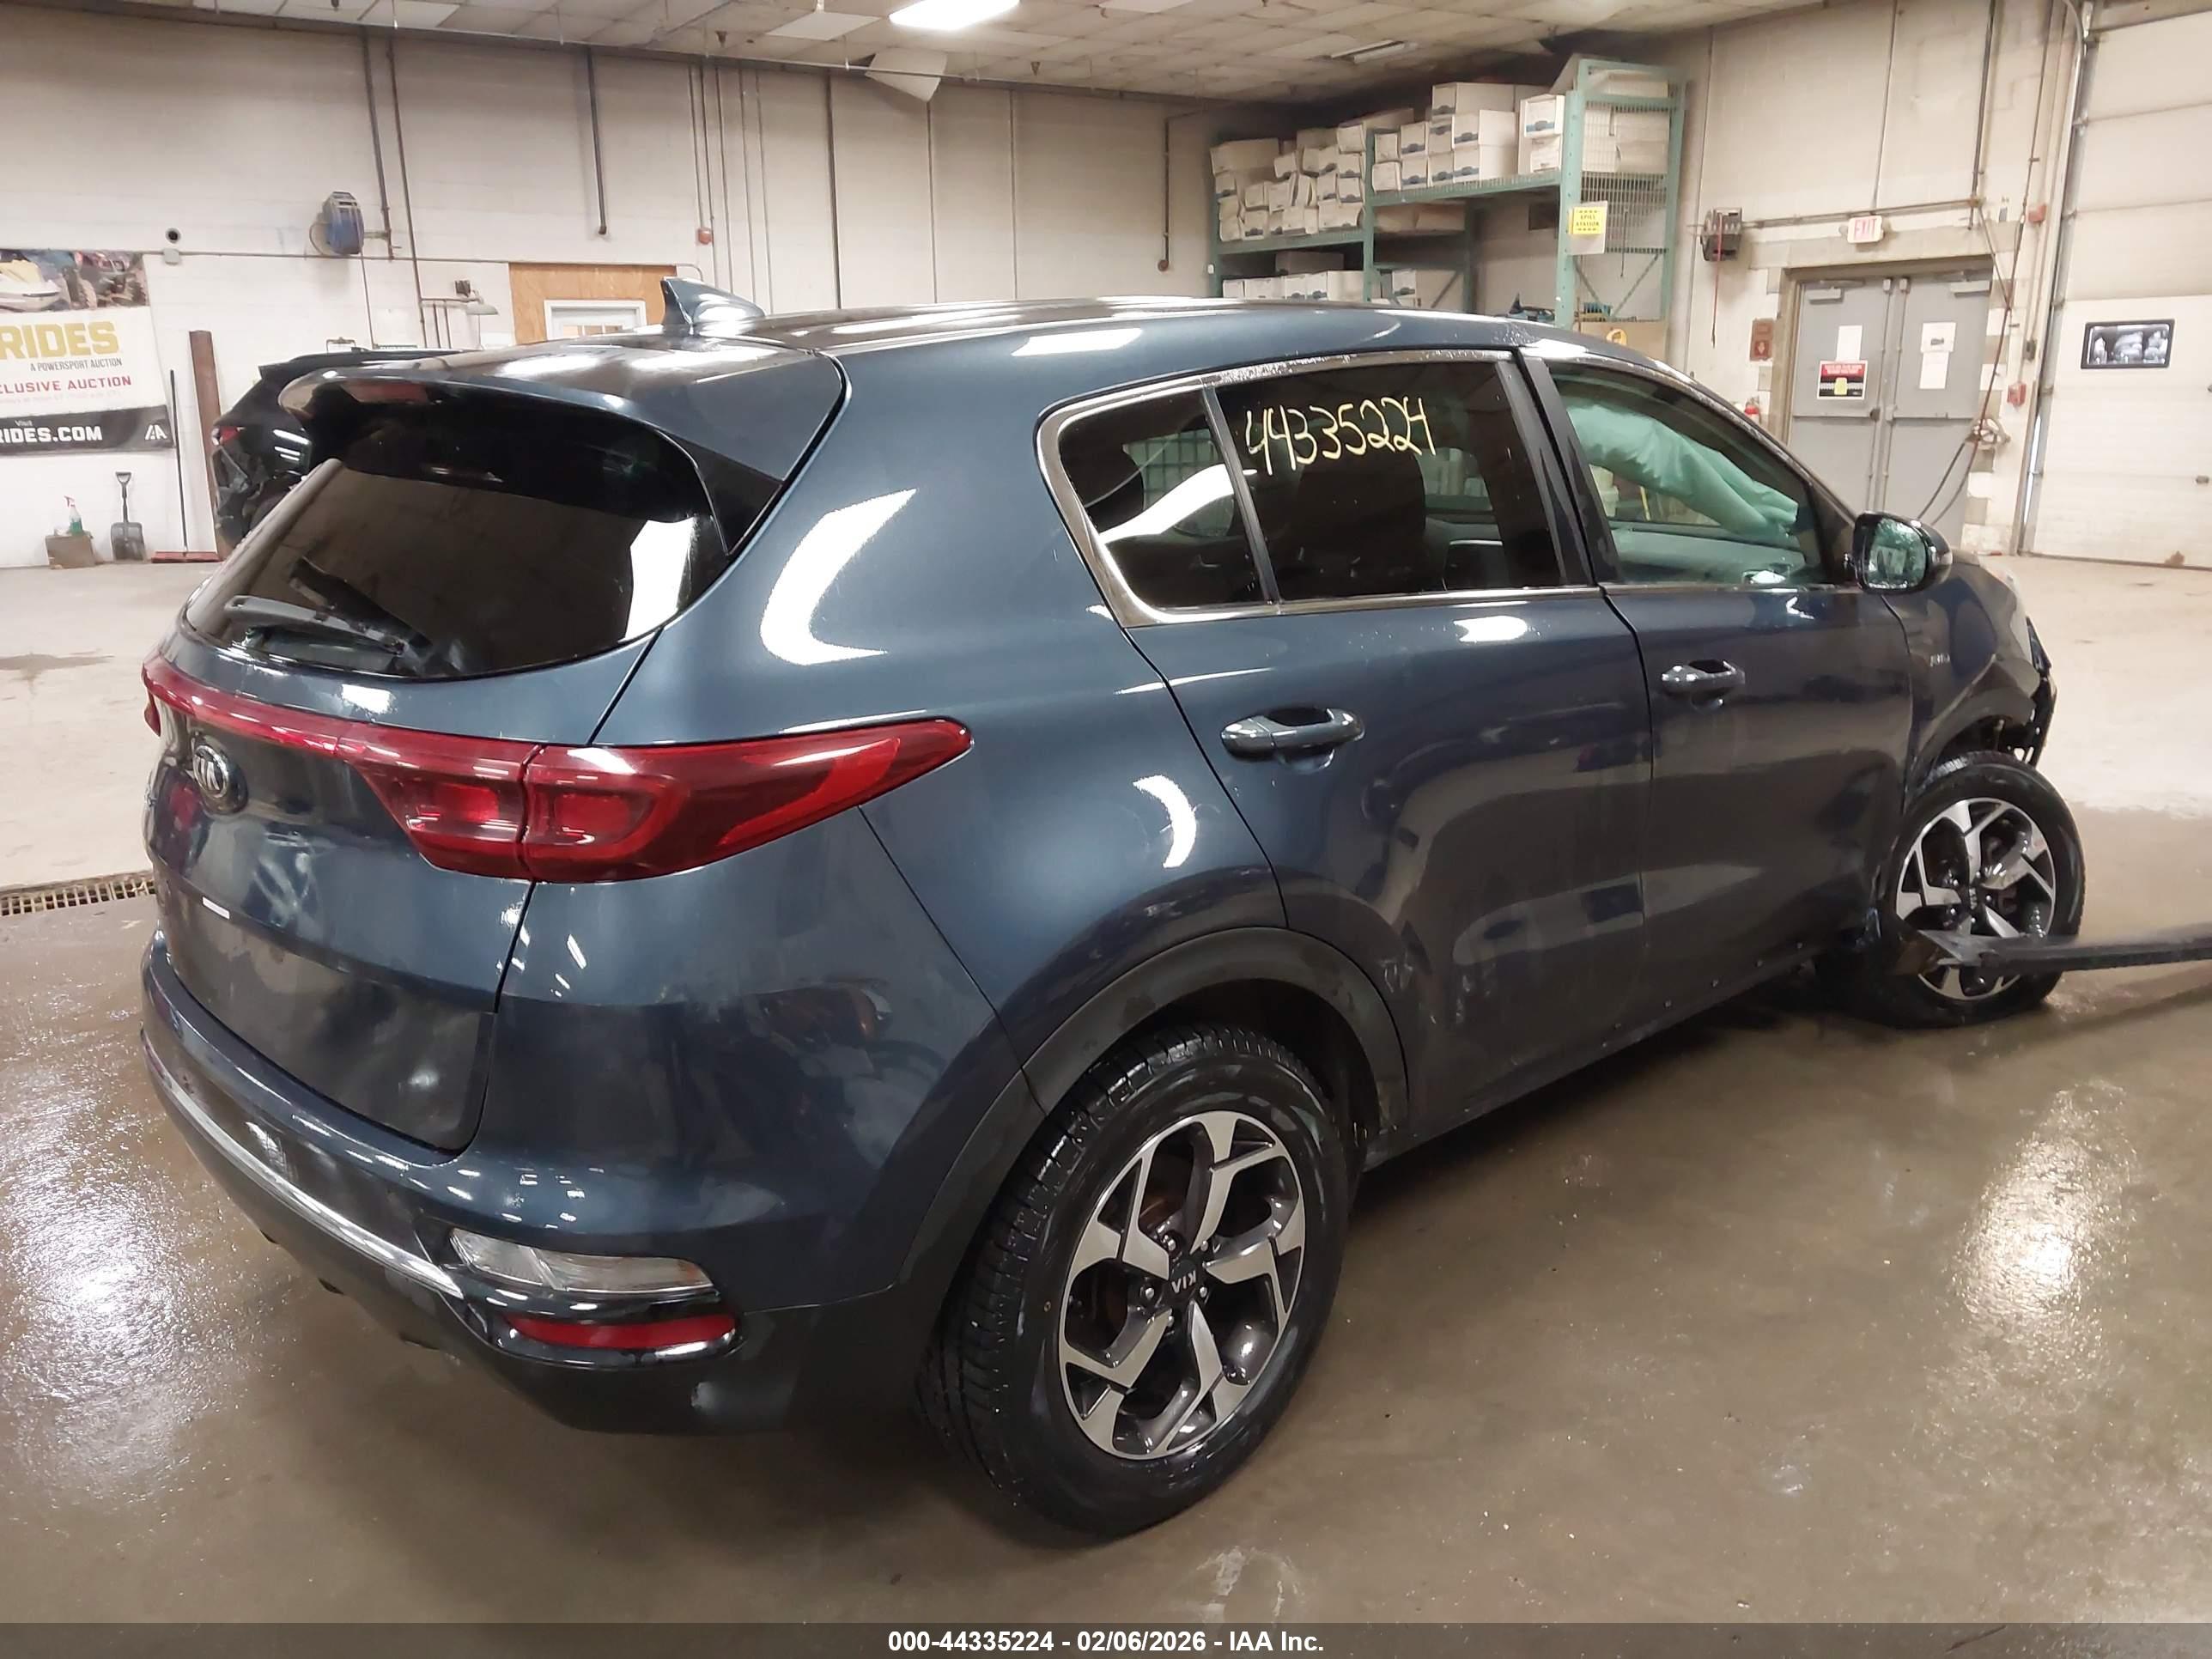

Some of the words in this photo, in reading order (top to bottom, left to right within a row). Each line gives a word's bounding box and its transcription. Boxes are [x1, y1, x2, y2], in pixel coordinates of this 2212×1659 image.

[1855, 218, 1877, 236] EXIT
[0, 321, 119, 361] RIDES
[30, 363, 36, 372] A
[38, 359, 88, 372] POWERSPORT
[90, 357, 123, 368] AUCTION
[0, 380, 61, 395] LUSIVE
[67, 375, 132, 391] AUCTION
[1245, 396, 1437, 476] 44335224
[1171, 1269, 1196, 1293] KIA
